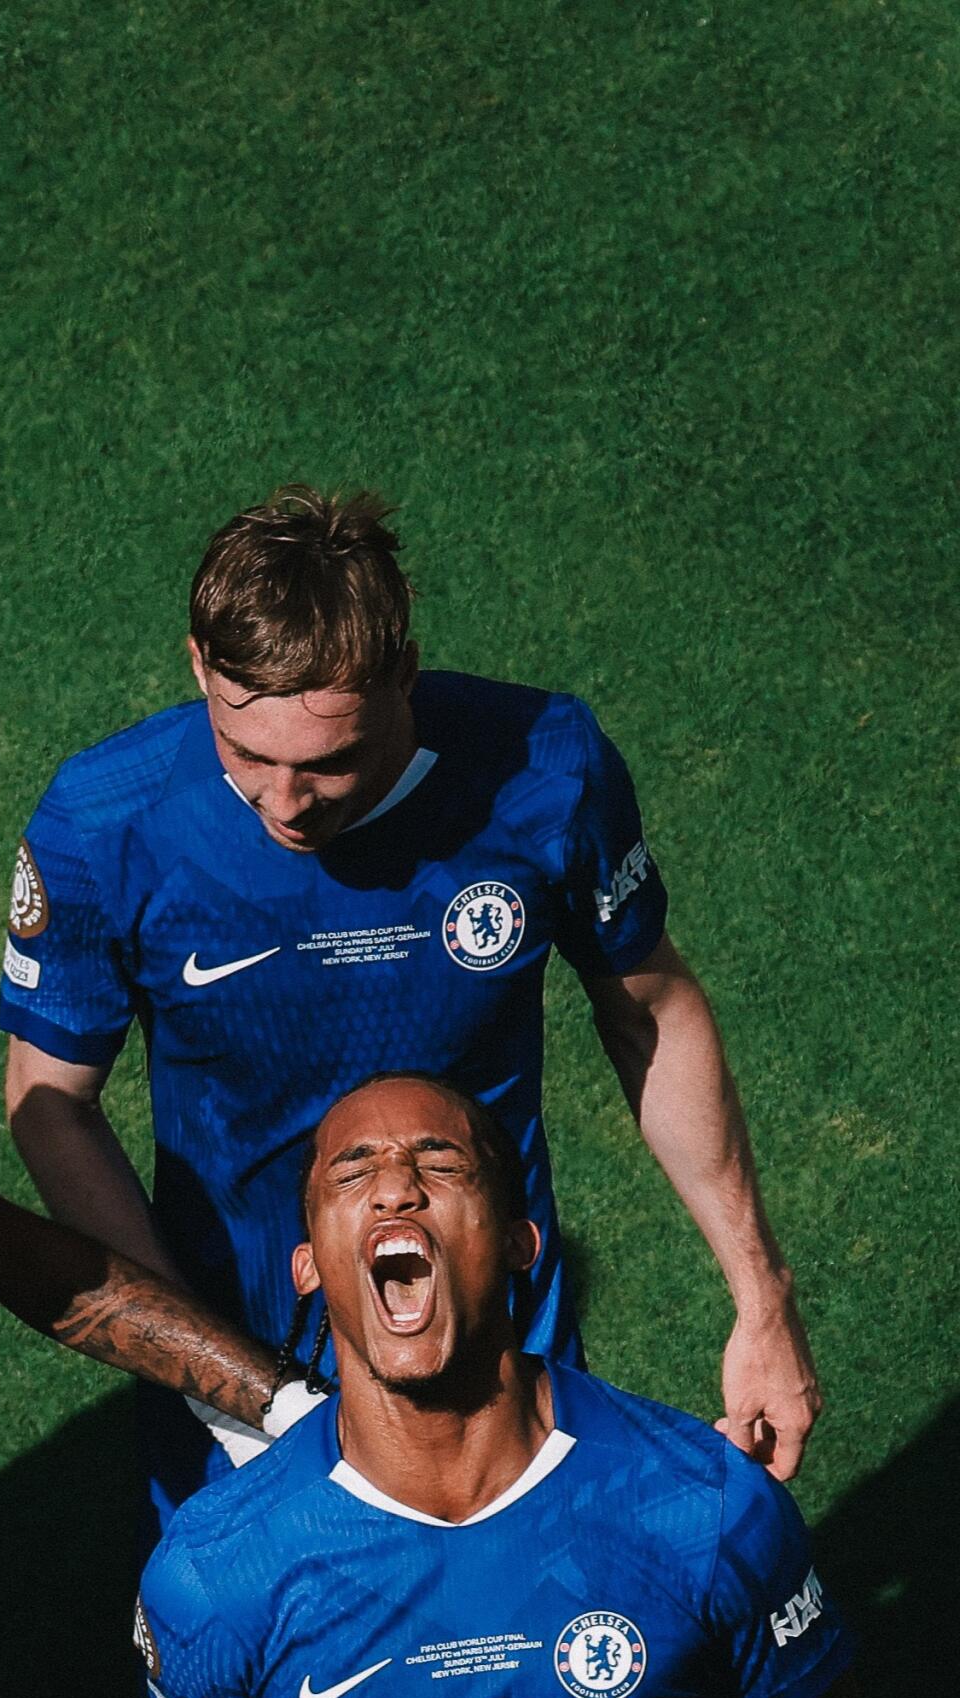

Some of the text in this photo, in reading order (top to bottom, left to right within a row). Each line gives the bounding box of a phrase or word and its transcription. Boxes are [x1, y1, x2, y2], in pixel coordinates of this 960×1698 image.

[454, 885, 505, 912] CHELSEA
[297, 942, 333, 950] CHELSEA
[374, 930, 431, 944] SAINT-GERMAIN
[312, 924, 415, 940] FIFA CLUB WORLD CUP FINAL
[322, 957, 341, 966] NEW
[382, 951, 410, 960] JERSEY
[335, 947, 364, 956] SUNDAY
[378, 944, 396, 952] JULY
[463, 955, 499, 966] FOOTBALL
[571, 1615, 630, 1635] CHELSEA
[420, 1645, 436, 1653] FIFA
[436, 1642, 458, 1650] CLUB
[458, 1639, 486, 1648] WORLD
[504, 1633, 526, 1642] FINAL
[406, 1655, 442, 1664] CHELSEA
[461, 1648, 483, 1656] PARIS
[483, 1641, 543, 1655] SAINT-GERMAIN
[443, 1659, 474, 1668] SUNDAY
[488, 1653, 506, 1661] JULY
[431, 1671, 451, 1679] NEW
[473, 1664, 492, 1672] NEW
[492, 1661, 520, 1671] JERSEY
[569, 1681, 631, 1698] FOOTBALL CLUB
